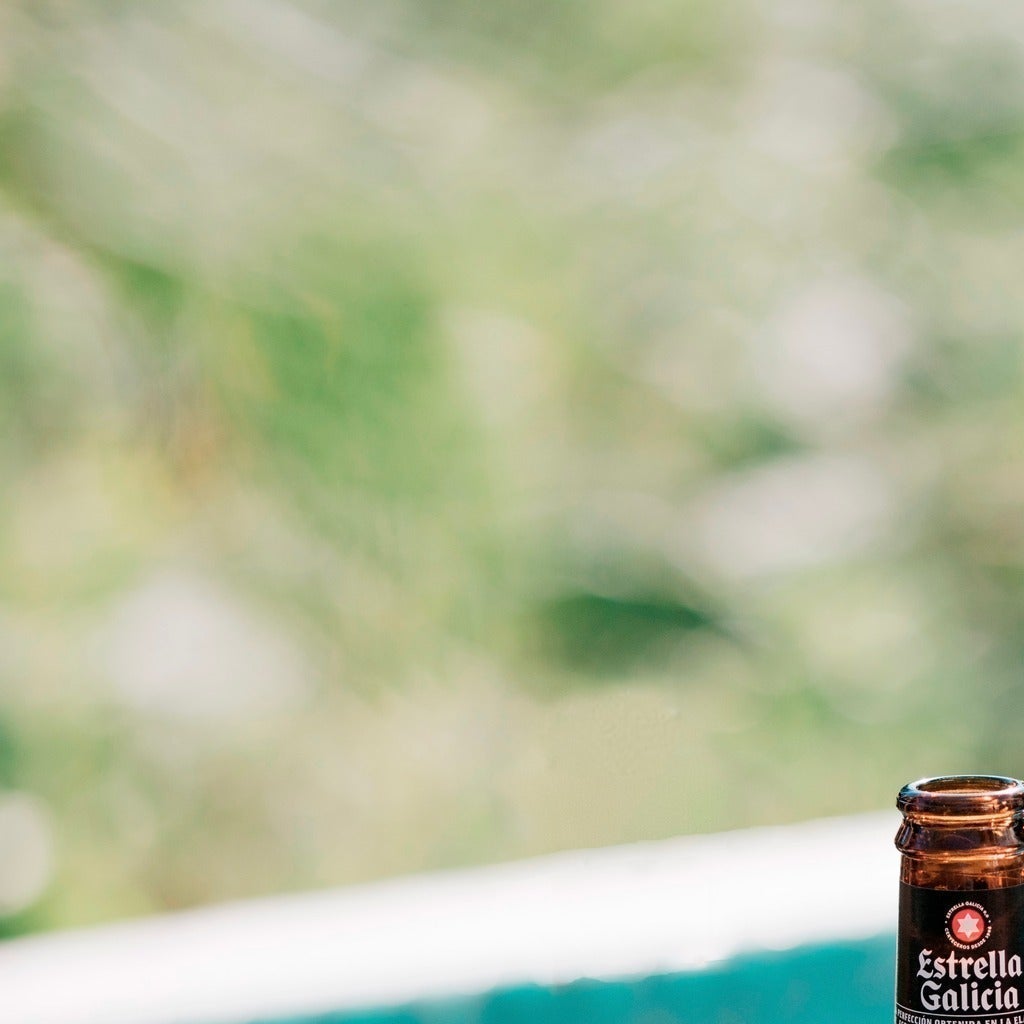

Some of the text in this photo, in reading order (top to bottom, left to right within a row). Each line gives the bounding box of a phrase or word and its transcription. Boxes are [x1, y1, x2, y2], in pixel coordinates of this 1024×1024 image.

[946, 902, 964, 918] ESTRELLA
[965, 901, 984, 911] GALICIA
[944, 928, 970, 950] CERVECEROS
[970, 938, 986, 950] DESDE
[916, 948, 1023, 980] Estrella
[920, 980, 1020, 1011] Galicia
